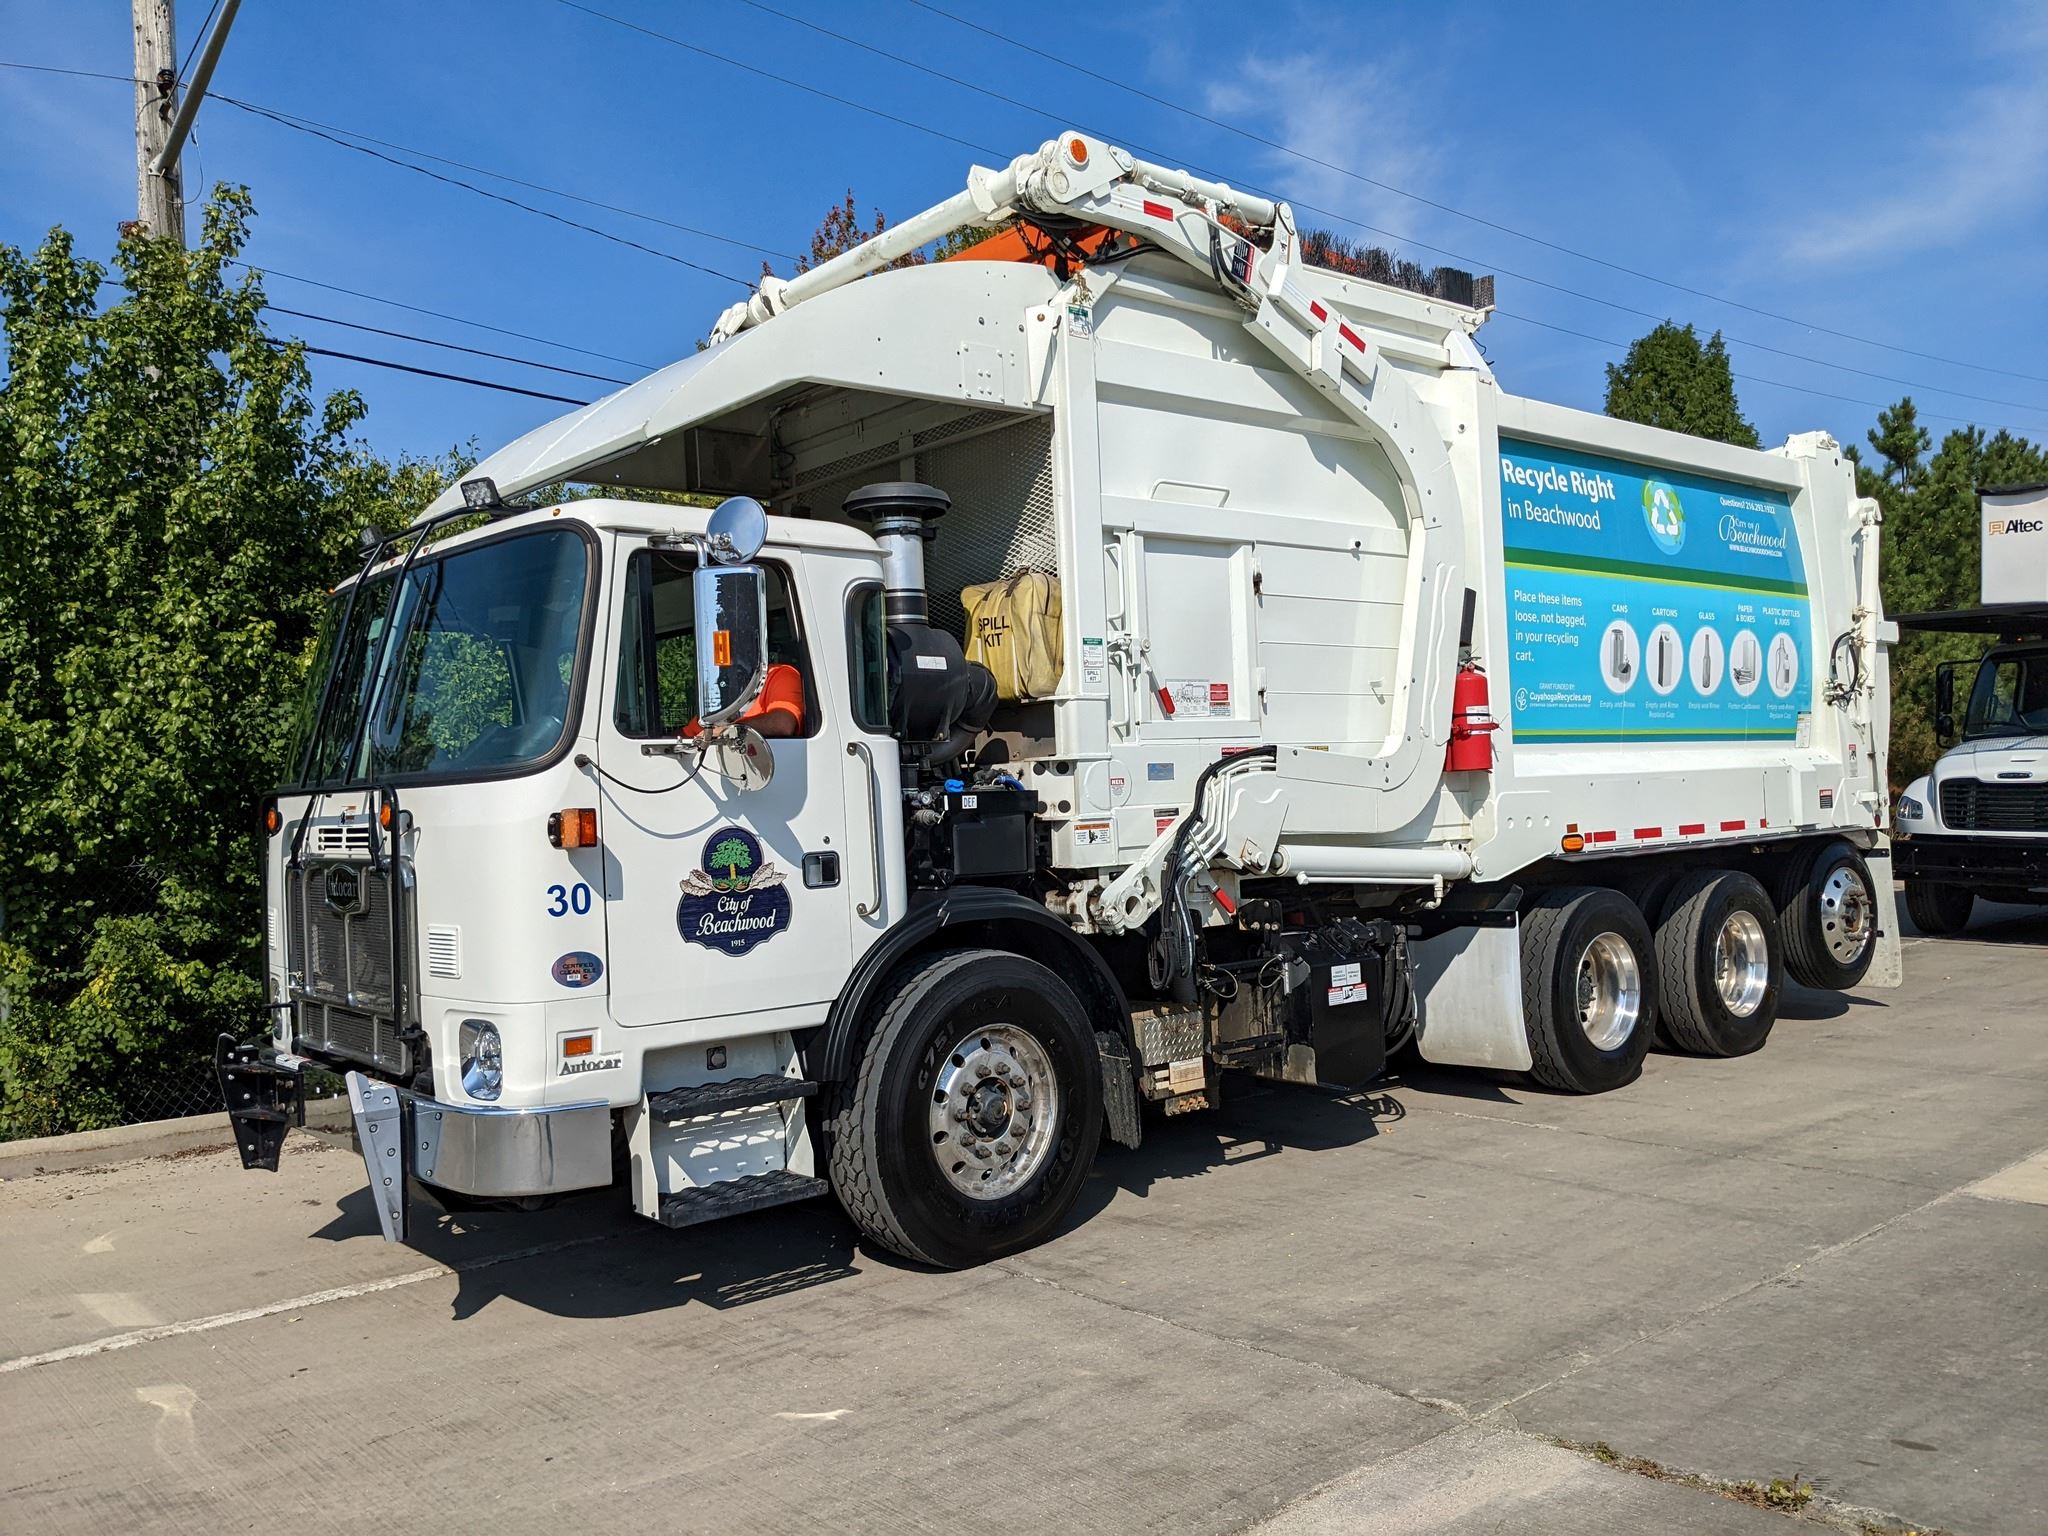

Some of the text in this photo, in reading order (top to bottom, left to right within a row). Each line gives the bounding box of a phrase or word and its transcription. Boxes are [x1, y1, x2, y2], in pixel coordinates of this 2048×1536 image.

[1501, 458, 1616, 504] Recycle Right
[1507, 497, 1601, 531] in Beachwood
[1719, 514, 1787, 550] Beachwood
[2005, 519, 2044, 534] Altec
[1514, 590, 1583, 607] Place these items
[1611, 603, 1629, 614] CANS
[1652, 607, 1678, 618] CARTONS
[1737, 603, 1753, 613] PAPER
[1762, 607, 1801, 618] PLASTIC BOTTLES
[1541, 613, 1554, 624] not
[1556, 612, 1587, 628] bagged,
[1698, 611, 1716, 621] GLASS
[978, 616, 1010, 632] SPILL
[983, 633, 1003, 648] KIT
[1515, 629, 1579, 647] in your recycling
[1515, 651, 1535, 662] cart.
[1529, 692, 1592, 703] CuyahogaRecycles.org
[963, 797, 976, 808] DEF
[547, 882, 592, 918] 30
[717, 894, 754, 915] City of
[696, 908, 777, 936] Beachwood
[731, 939, 746, 948] 1915
[559, 1056, 622, 1077] Autocar
